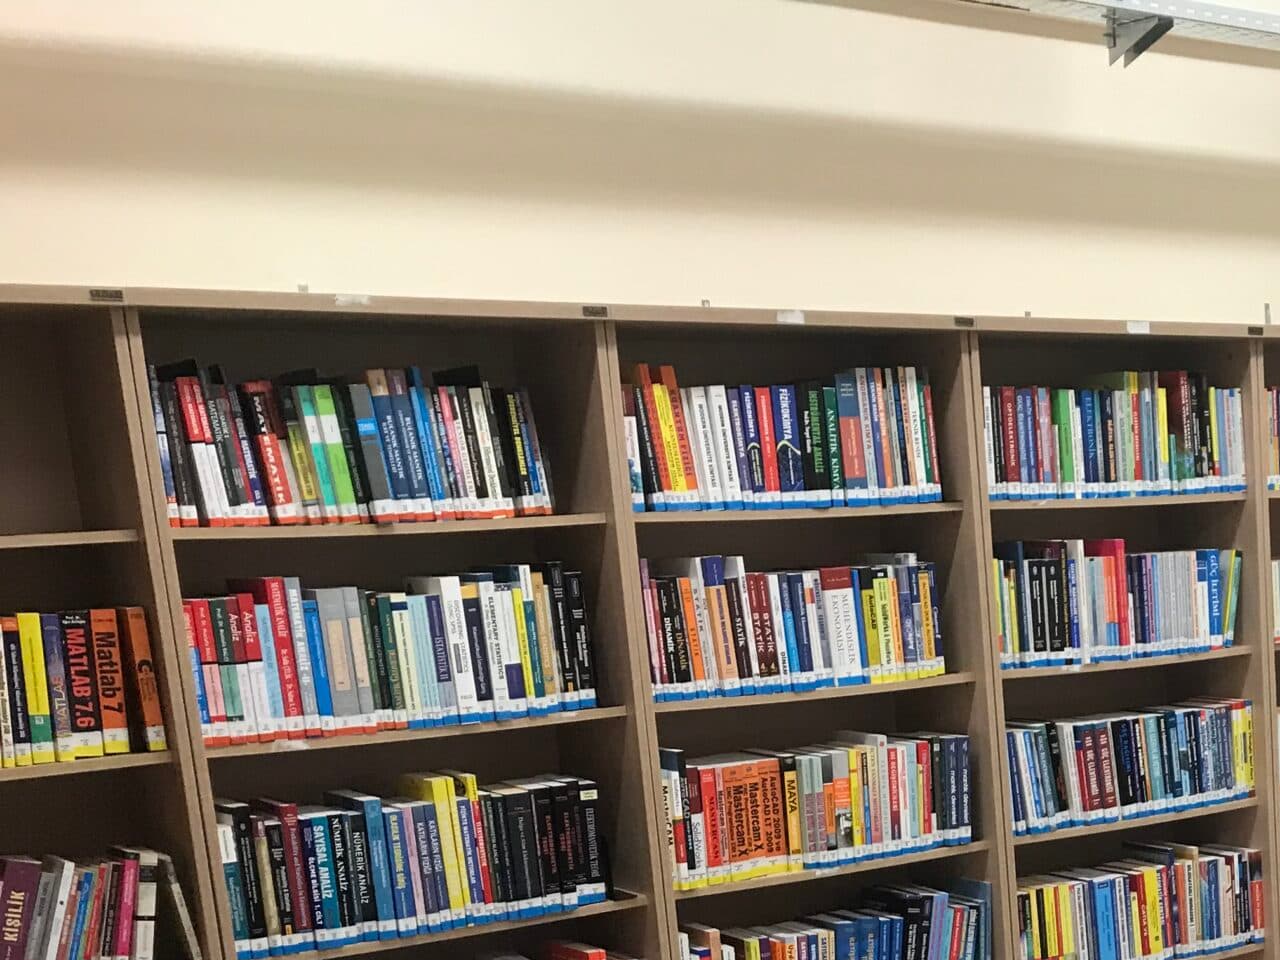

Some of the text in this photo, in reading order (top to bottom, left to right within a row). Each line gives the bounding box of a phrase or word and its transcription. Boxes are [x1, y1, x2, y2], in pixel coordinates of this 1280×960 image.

[778, 387, 794, 440] FİZİKOKİMYA
[252, 395, 286, 504] MATEMATİK
[825, 407, 841, 490] ANALİTİK KİMYA
[228, 613, 243, 643] Analiz
[241, 611, 257, 644] Analiz
[487, 596, 505, 680] ELEMENTARY STATISTICS
[663, 616, 675, 654] DİNAMİK
[752, 612, 766, 653] STATİK
[762, 612, 776, 653] STATİK
[65, 627, 95, 729] MATLAB 7.6
[94, 630, 124, 716] Matlab 7
[731, 785, 749, 857] Mastercam X
[747, 782, 764, 852] Mastercam X
[760, 777, 770, 816] AutoCAD
[770, 775, 780, 815] AutoCAD
[786, 779, 798, 814] MAYA
[330, 817, 348, 892] NÜMERİK ANALİZ
[772, 817, 782, 840] 2009
[312, 824, 336, 900] SAYISAL ANALİZ
[351, 831, 371, 905] NÜMERİK ANALİZ
[0, 889, 28, 943] KİŞİLİK
